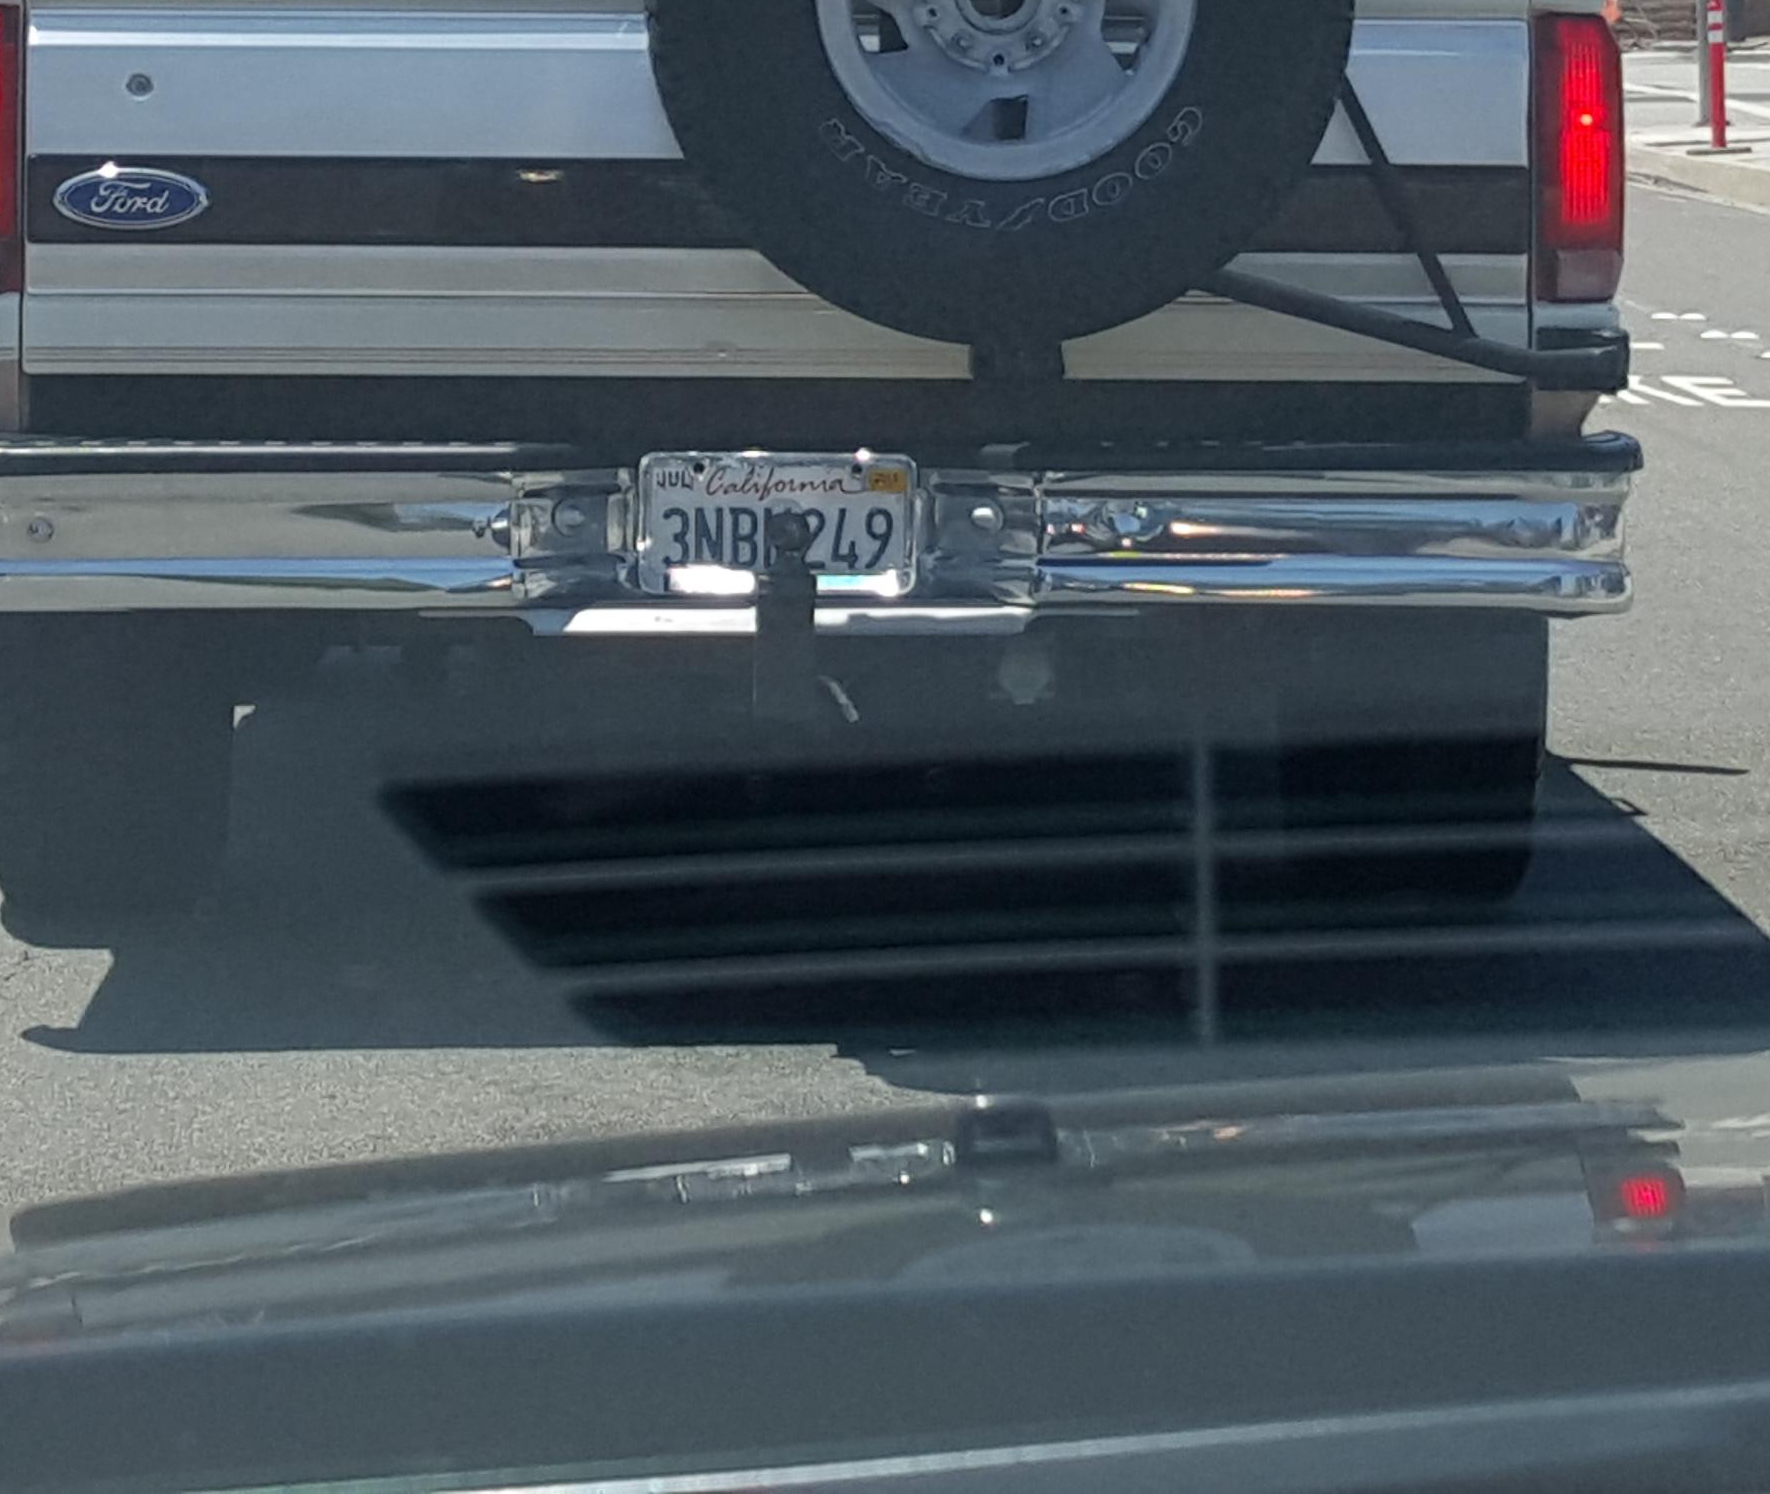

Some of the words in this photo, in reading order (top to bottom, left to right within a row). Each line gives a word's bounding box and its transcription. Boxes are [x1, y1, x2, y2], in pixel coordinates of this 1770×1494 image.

[90, 180, 171, 214] Ford
[656, 471, 692, 489] JUL
[706, 467, 866, 501] California
